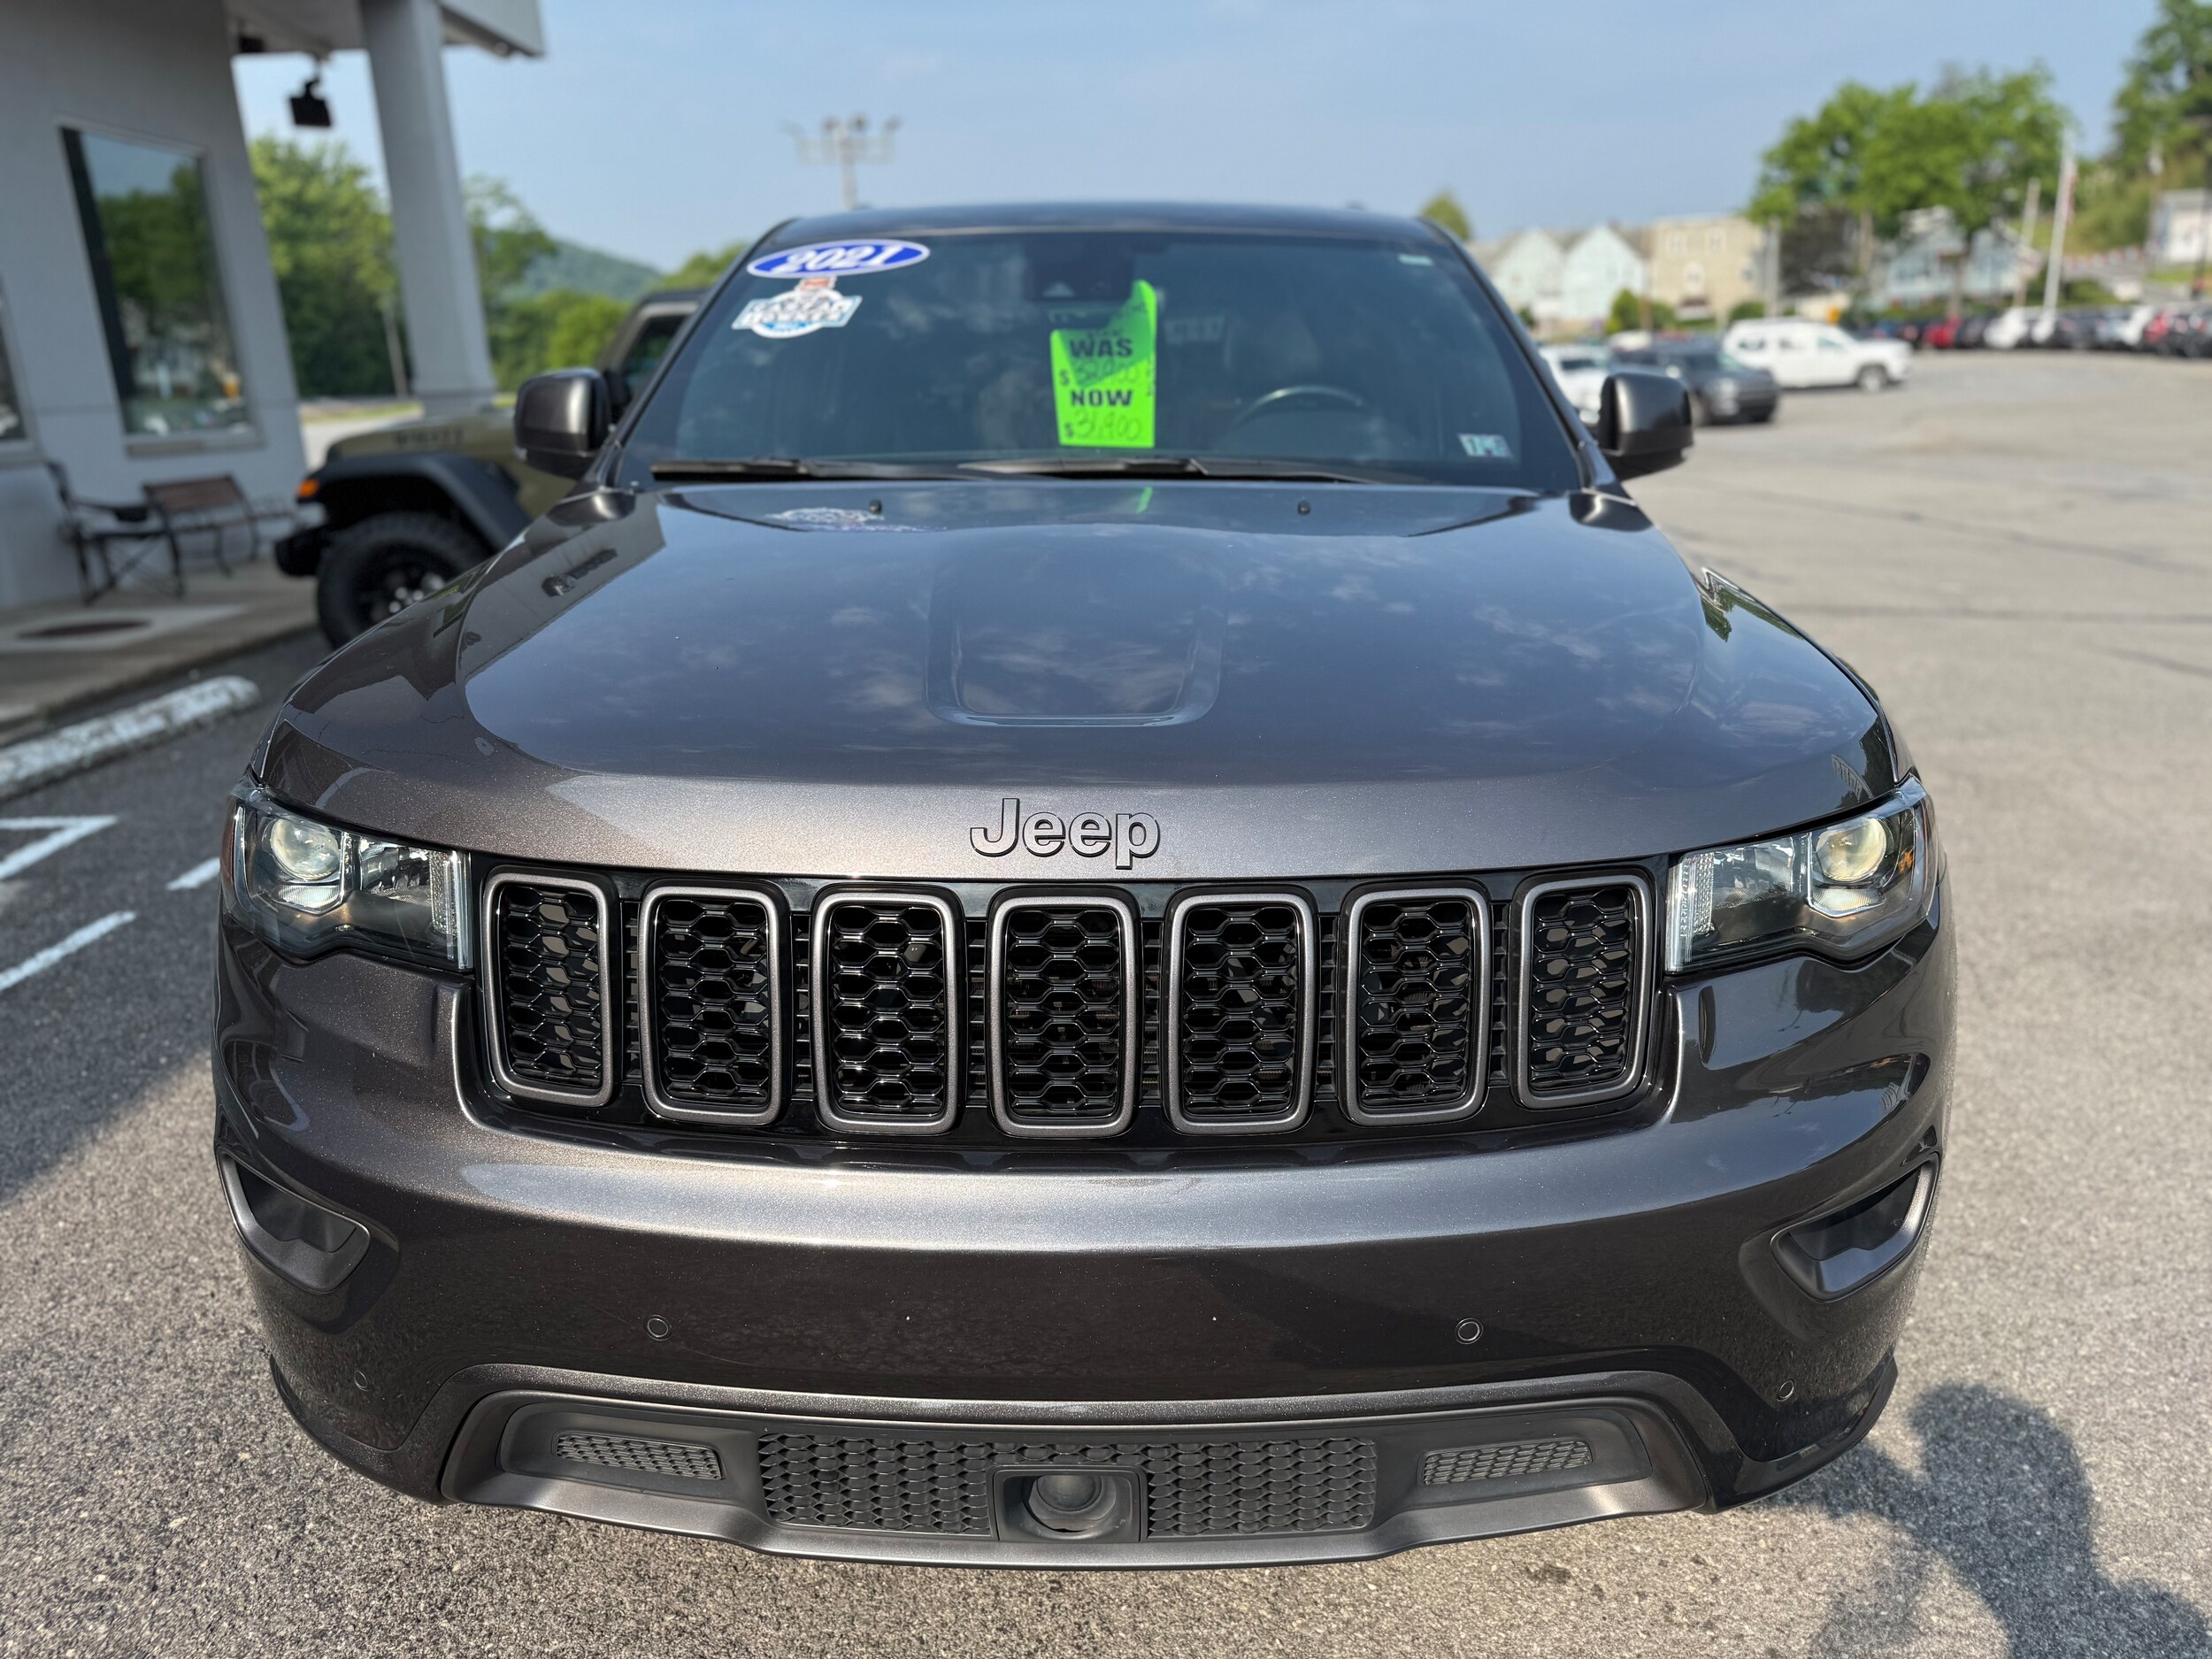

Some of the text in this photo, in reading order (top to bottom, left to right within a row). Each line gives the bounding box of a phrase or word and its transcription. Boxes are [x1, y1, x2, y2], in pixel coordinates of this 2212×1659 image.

[770, 244, 904, 273] 2021
[1069, 338, 1133, 358] WAS
[1071, 389, 1133, 407] NOW
[970, 797, 1161, 870] Jeep
